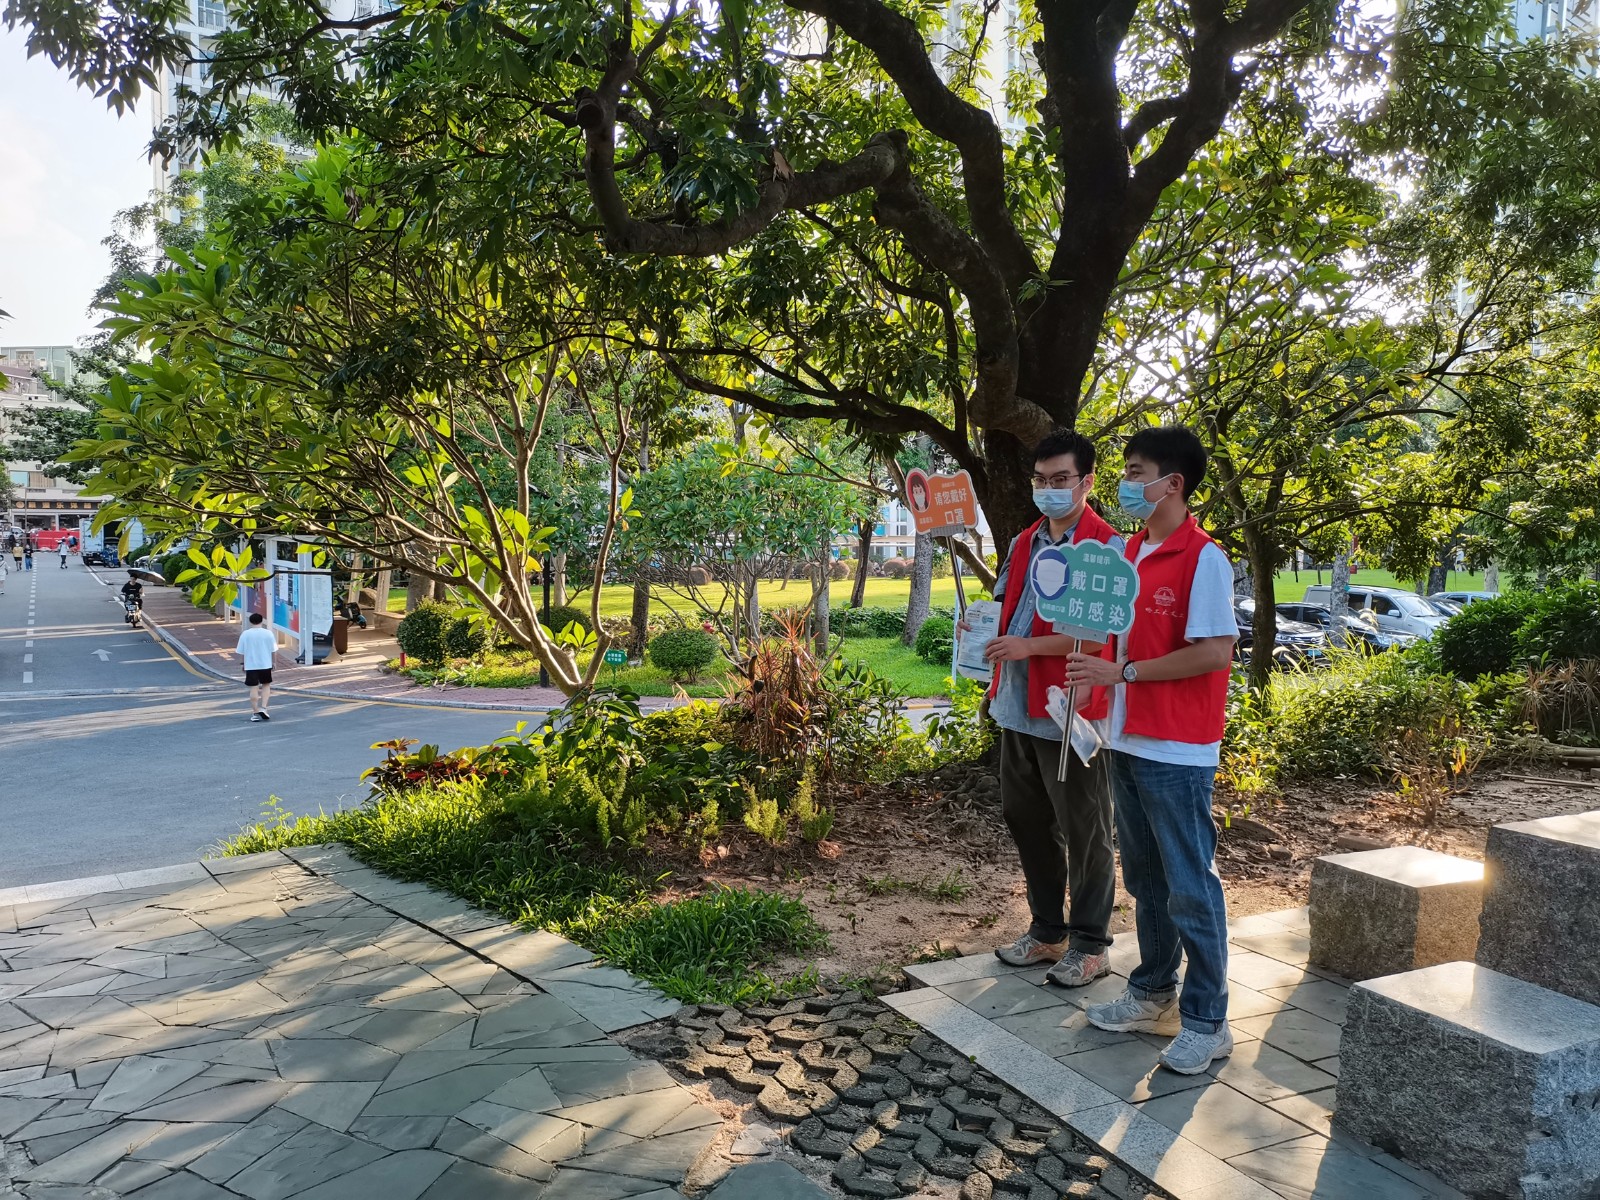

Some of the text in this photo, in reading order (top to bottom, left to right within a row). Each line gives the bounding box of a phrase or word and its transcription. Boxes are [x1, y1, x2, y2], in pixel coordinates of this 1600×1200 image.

[934, 488, 967, 505] 请您戴好
[945, 508, 965, 524] 口罩
[1083, 553, 1111, 565] 温馨提示
[1071, 570, 1128, 597] 戴口罩
[1068, 597, 1125, 626] 防感染
